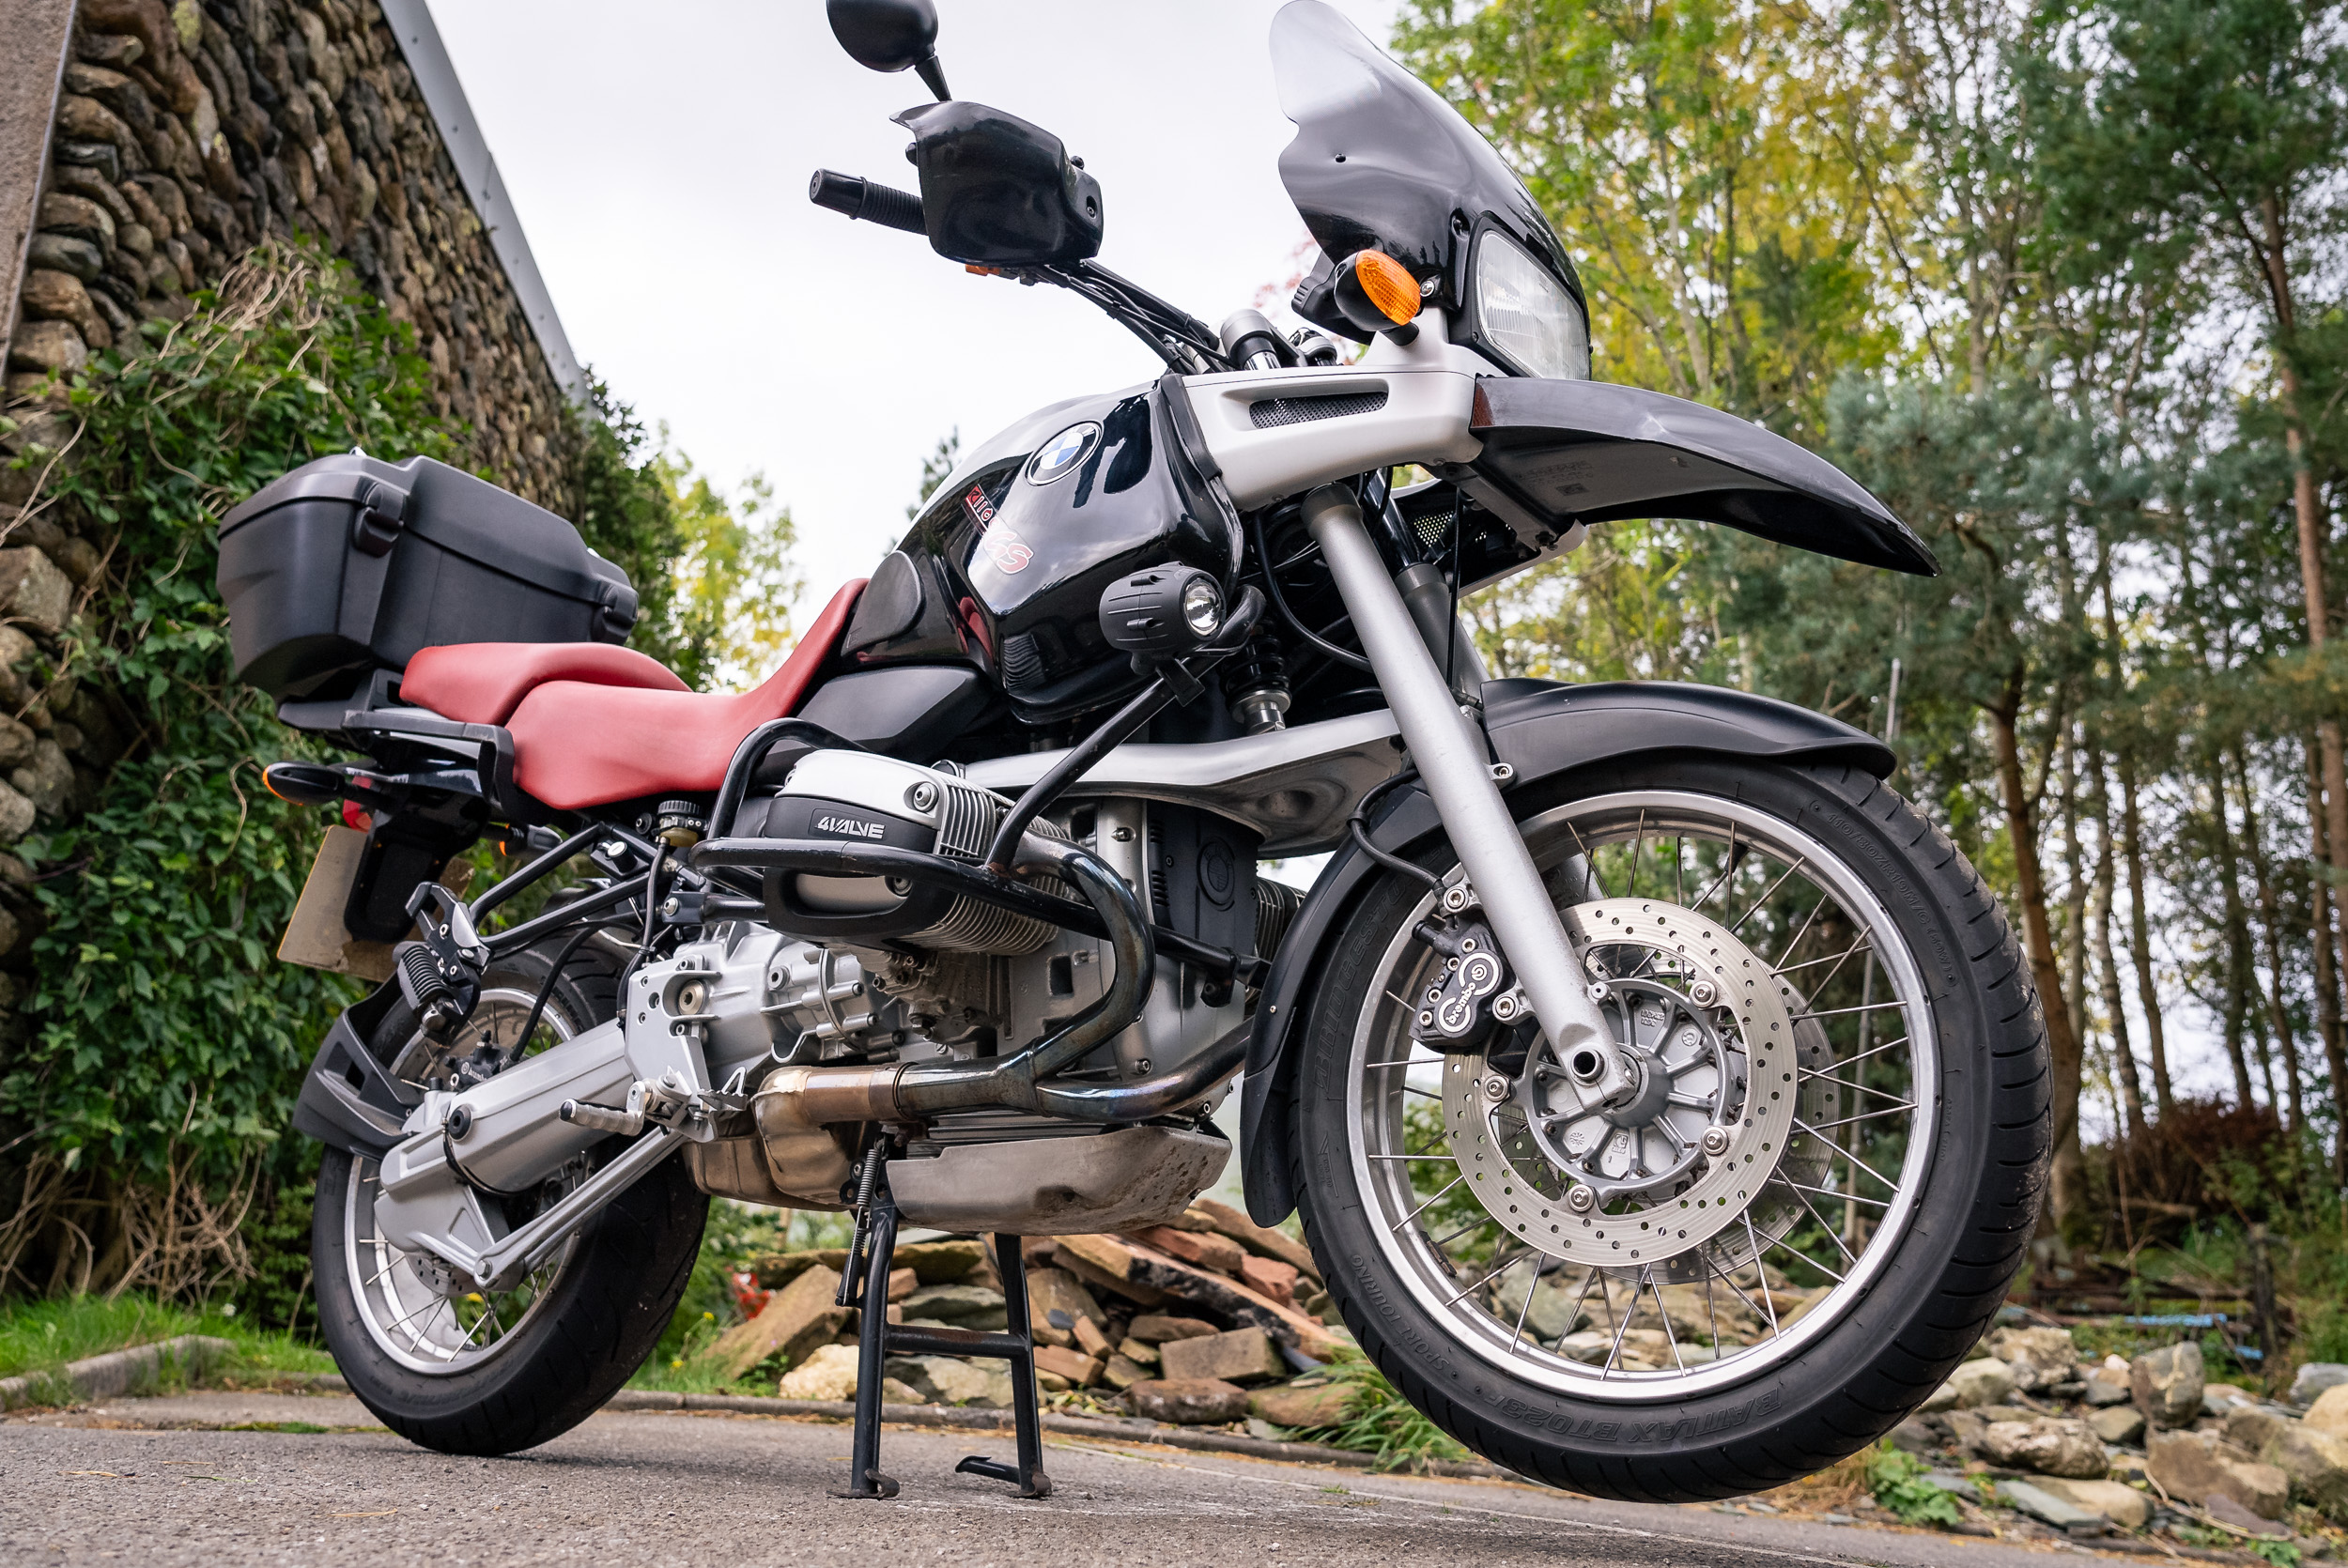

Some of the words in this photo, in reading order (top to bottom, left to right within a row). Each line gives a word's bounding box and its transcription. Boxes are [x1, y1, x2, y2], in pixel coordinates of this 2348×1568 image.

[815, 816, 886, 839] 4VALVE
[1314, 846, 1441, 1092] BRIDGESTOE
[1444, 980, 1475, 1024] brembo
[1351, 1253, 1400, 1324] TOURING
[1395, 1325, 1450, 1371] SPORT
[1629, 1388, 1780, 1442] BATTLAX
